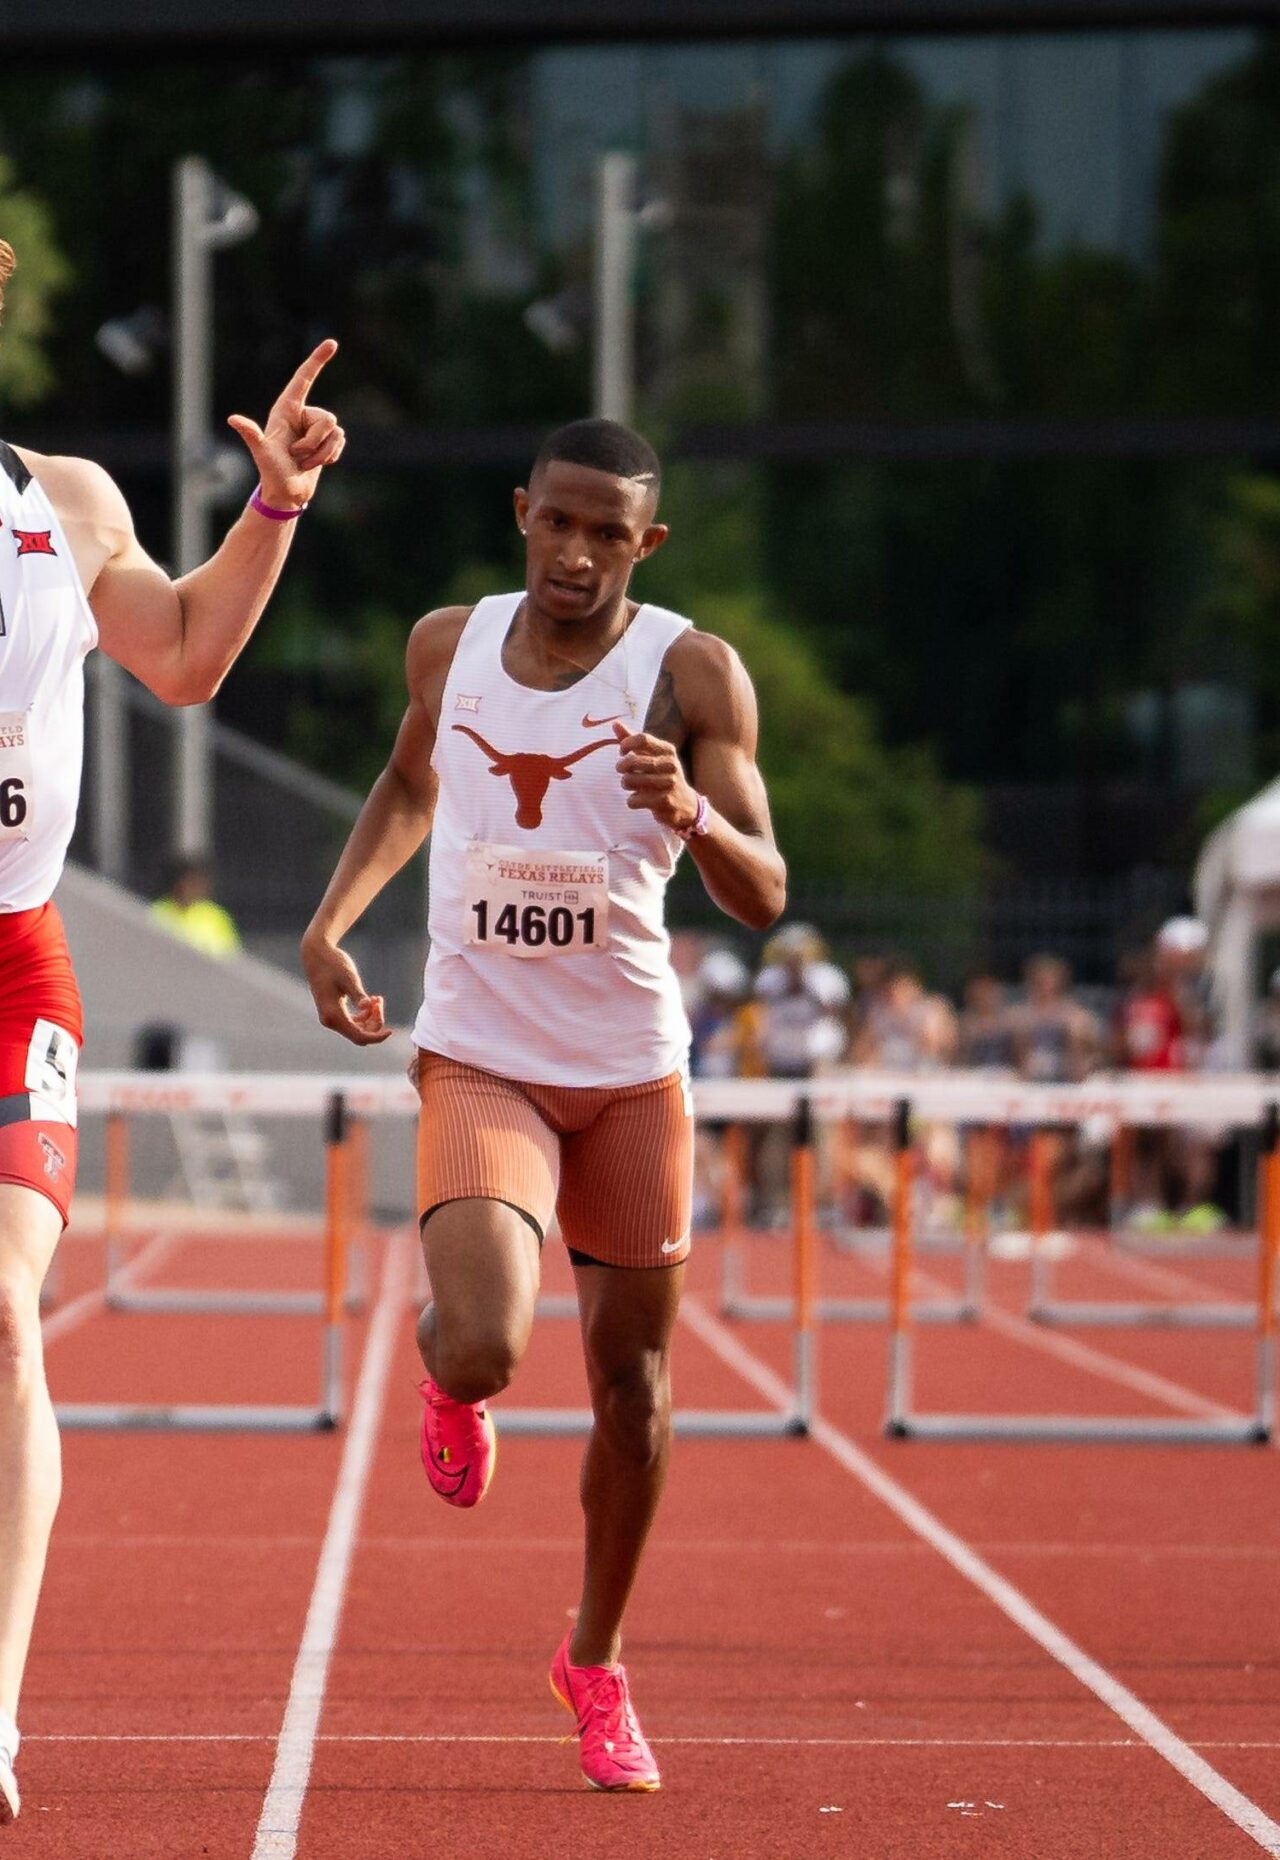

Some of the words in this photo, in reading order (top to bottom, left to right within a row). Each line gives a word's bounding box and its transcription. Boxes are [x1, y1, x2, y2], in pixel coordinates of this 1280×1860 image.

[498, 867, 545, 882] TEXAS
[549, 872, 605, 884] RELAYS
[521, 890, 562, 901] TRUIST
[472, 899, 595, 947] 14601
